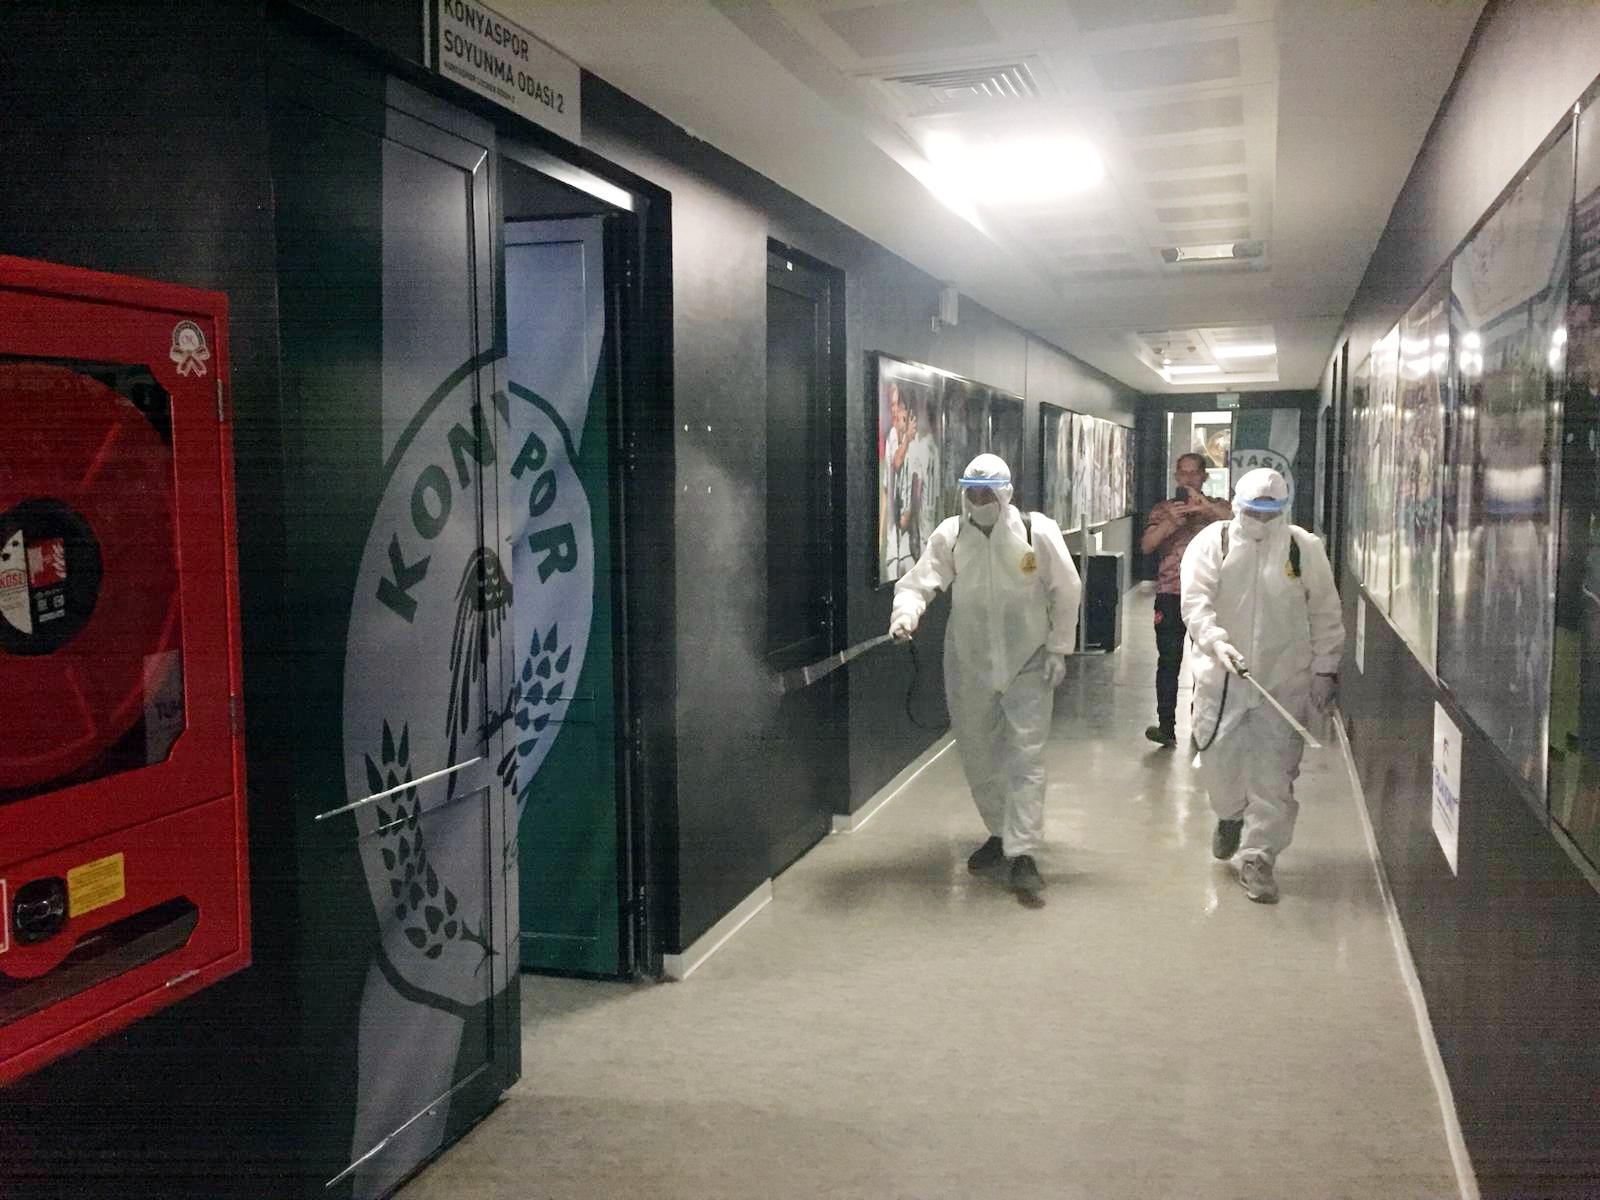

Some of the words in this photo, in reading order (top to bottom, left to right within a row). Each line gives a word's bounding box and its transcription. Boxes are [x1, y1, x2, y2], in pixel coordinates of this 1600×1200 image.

[444, 0, 529, 62] KONYASPOR
[444, 29, 515, 87] SOYUNMA
[518, 71, 554, 110] ODASI
[557, 93, 565, 114] 2
